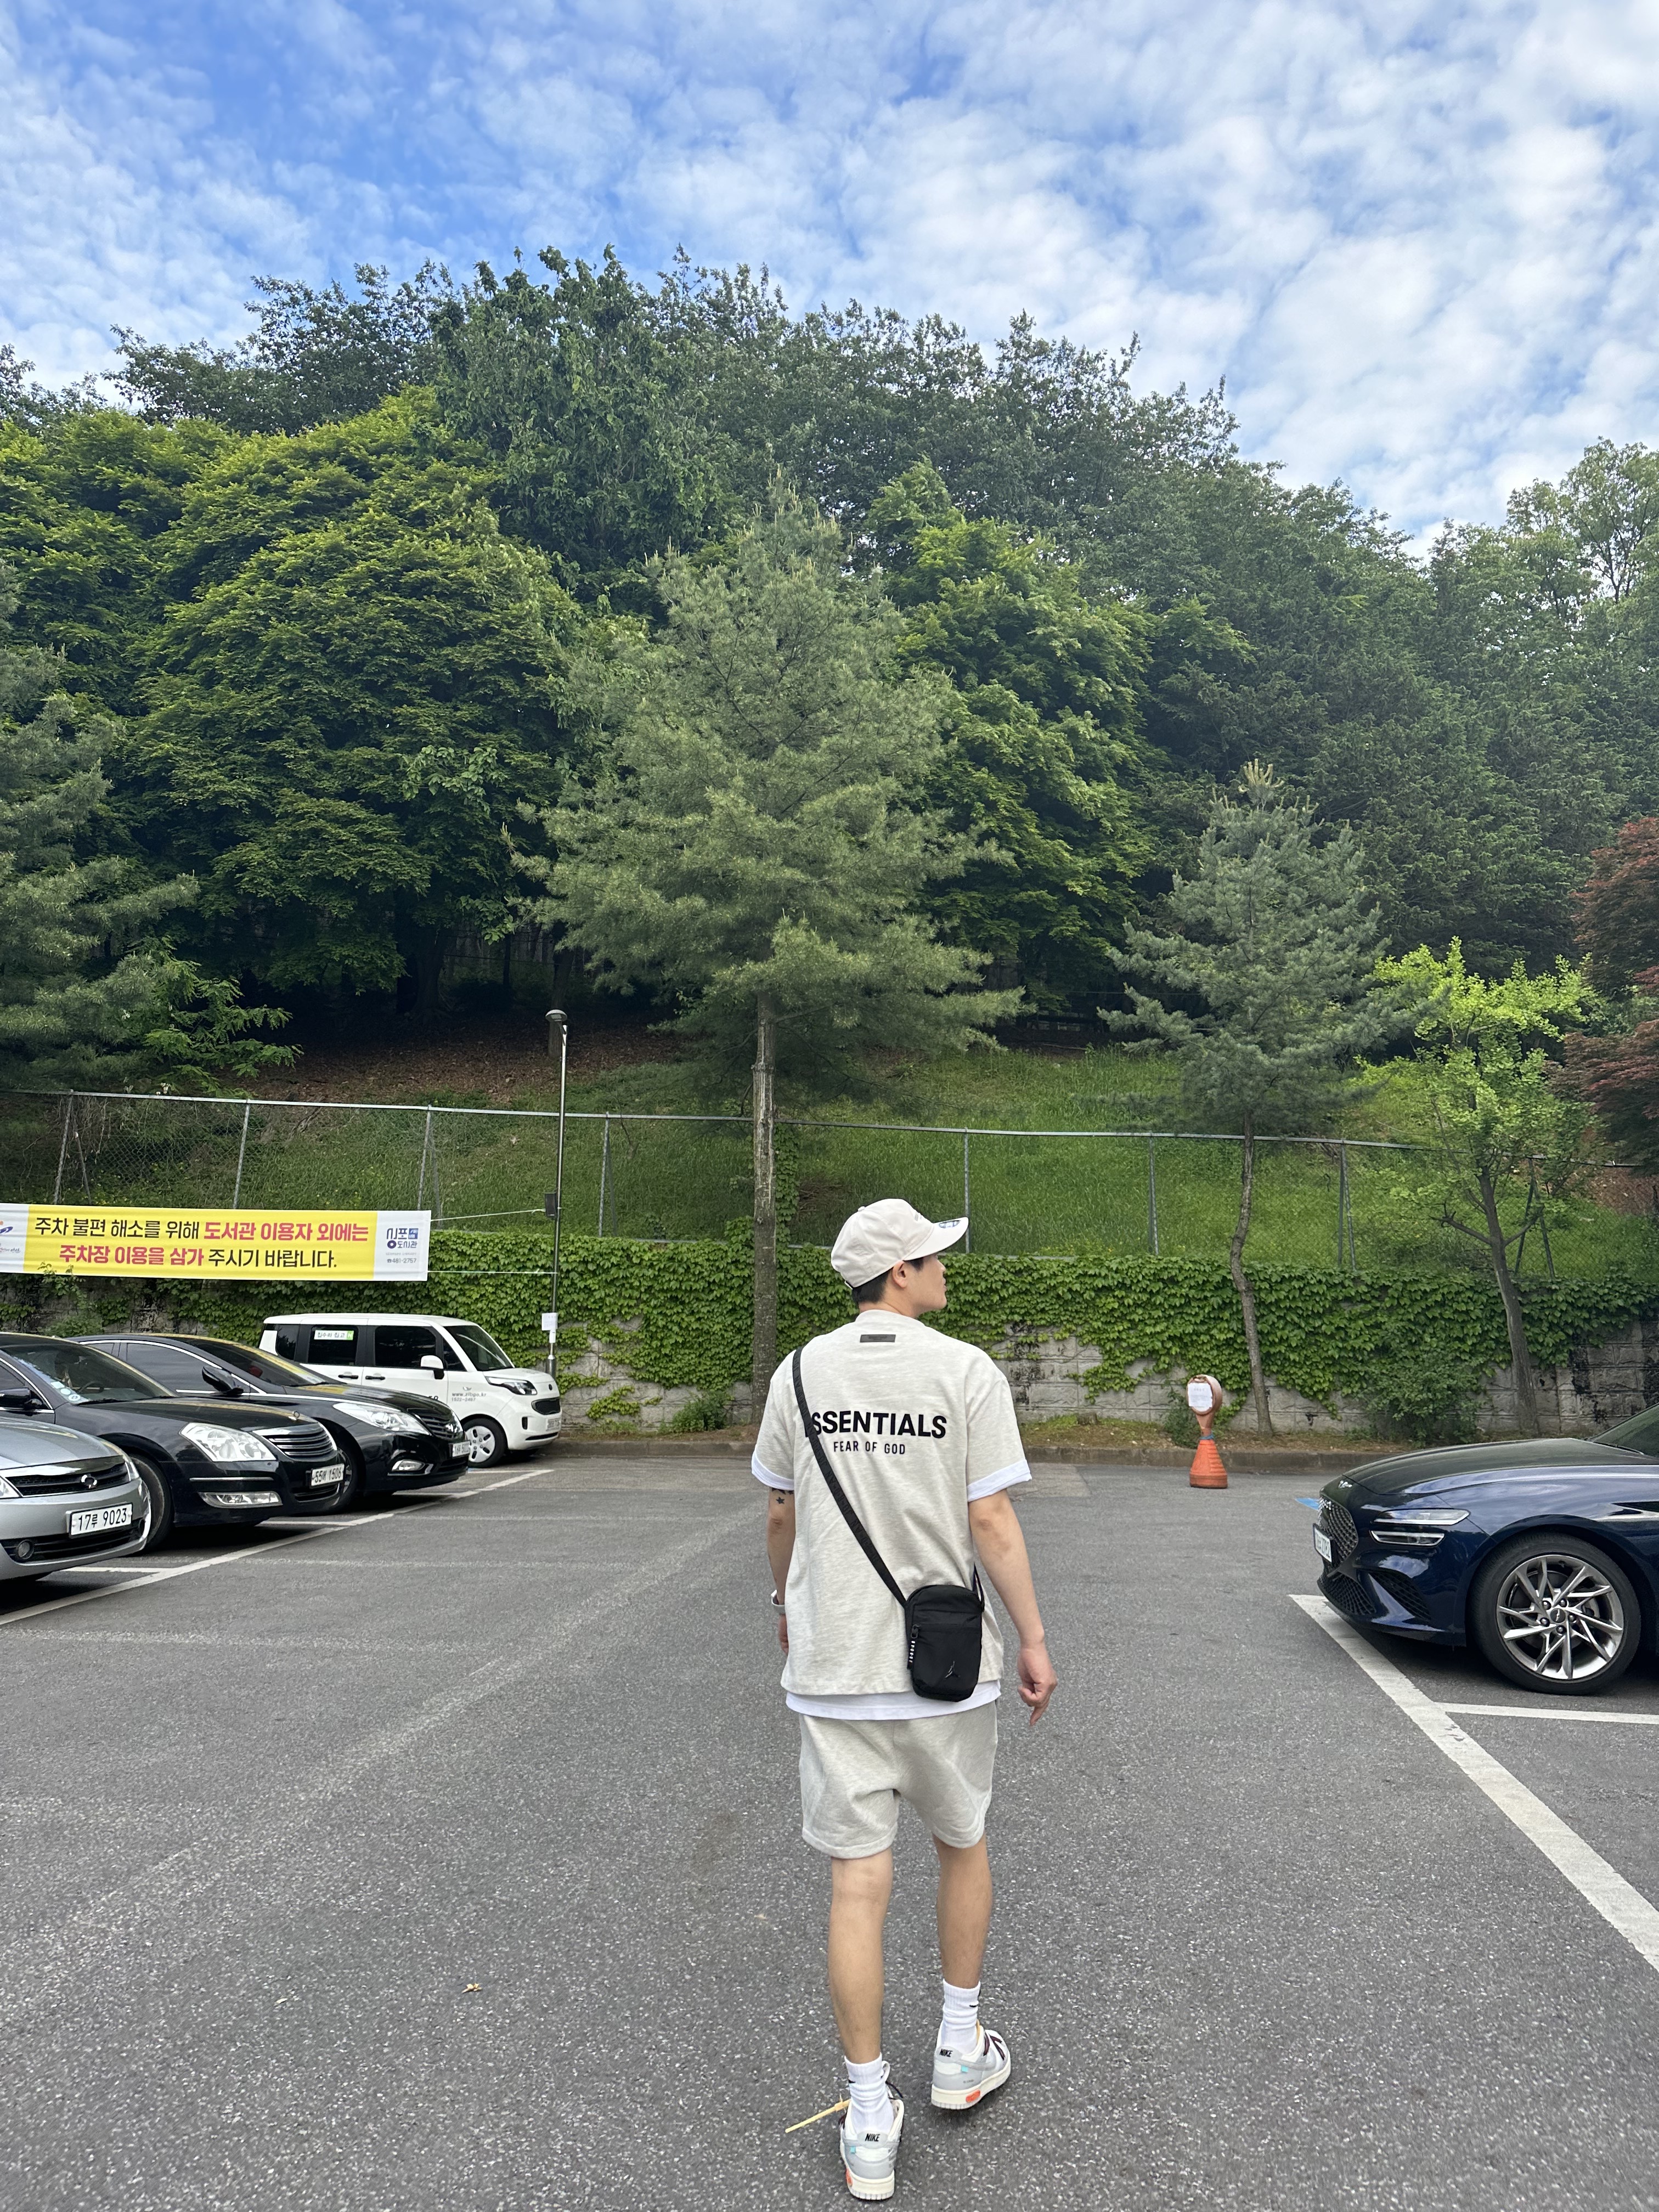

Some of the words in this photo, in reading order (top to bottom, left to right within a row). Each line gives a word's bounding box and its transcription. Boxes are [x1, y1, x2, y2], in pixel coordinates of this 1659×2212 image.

[35, 1217, 69, 1235] 주차
[73, 1218, 106, 1237] 불편
[111, 1219, 160, 1238] 해소를
[166, 1221, 200, 1239] 위해
[204, 1222, 256, 1240] 도서관
[261, 1222, 313, 1241] 이용자
[317, 1223, 369, 1242] 외에는
[59, 1244, 110, 1264] 주차장
[115, 1245, 165, 1265] 이용을
[170, 1248, 204, 1266] 삼가
[208, 1249, 259, 1267] 주시기
[264, 1249, 337, 1268] 바랍니다.
[805, 1410, 947, 1438] SSENTIALS
[833, 1441, 859, 1452] FEAR
[865, 1441, 878, 1452] OF
[884, 1443, 906, 1454] GOD
[78, 1514, 98, 1531] 17루
[103, 1508, 127, 1527] 9023
[939, 2049, 953, 2057] NIKE
[865, 2133, 881, 2142] NIKE
